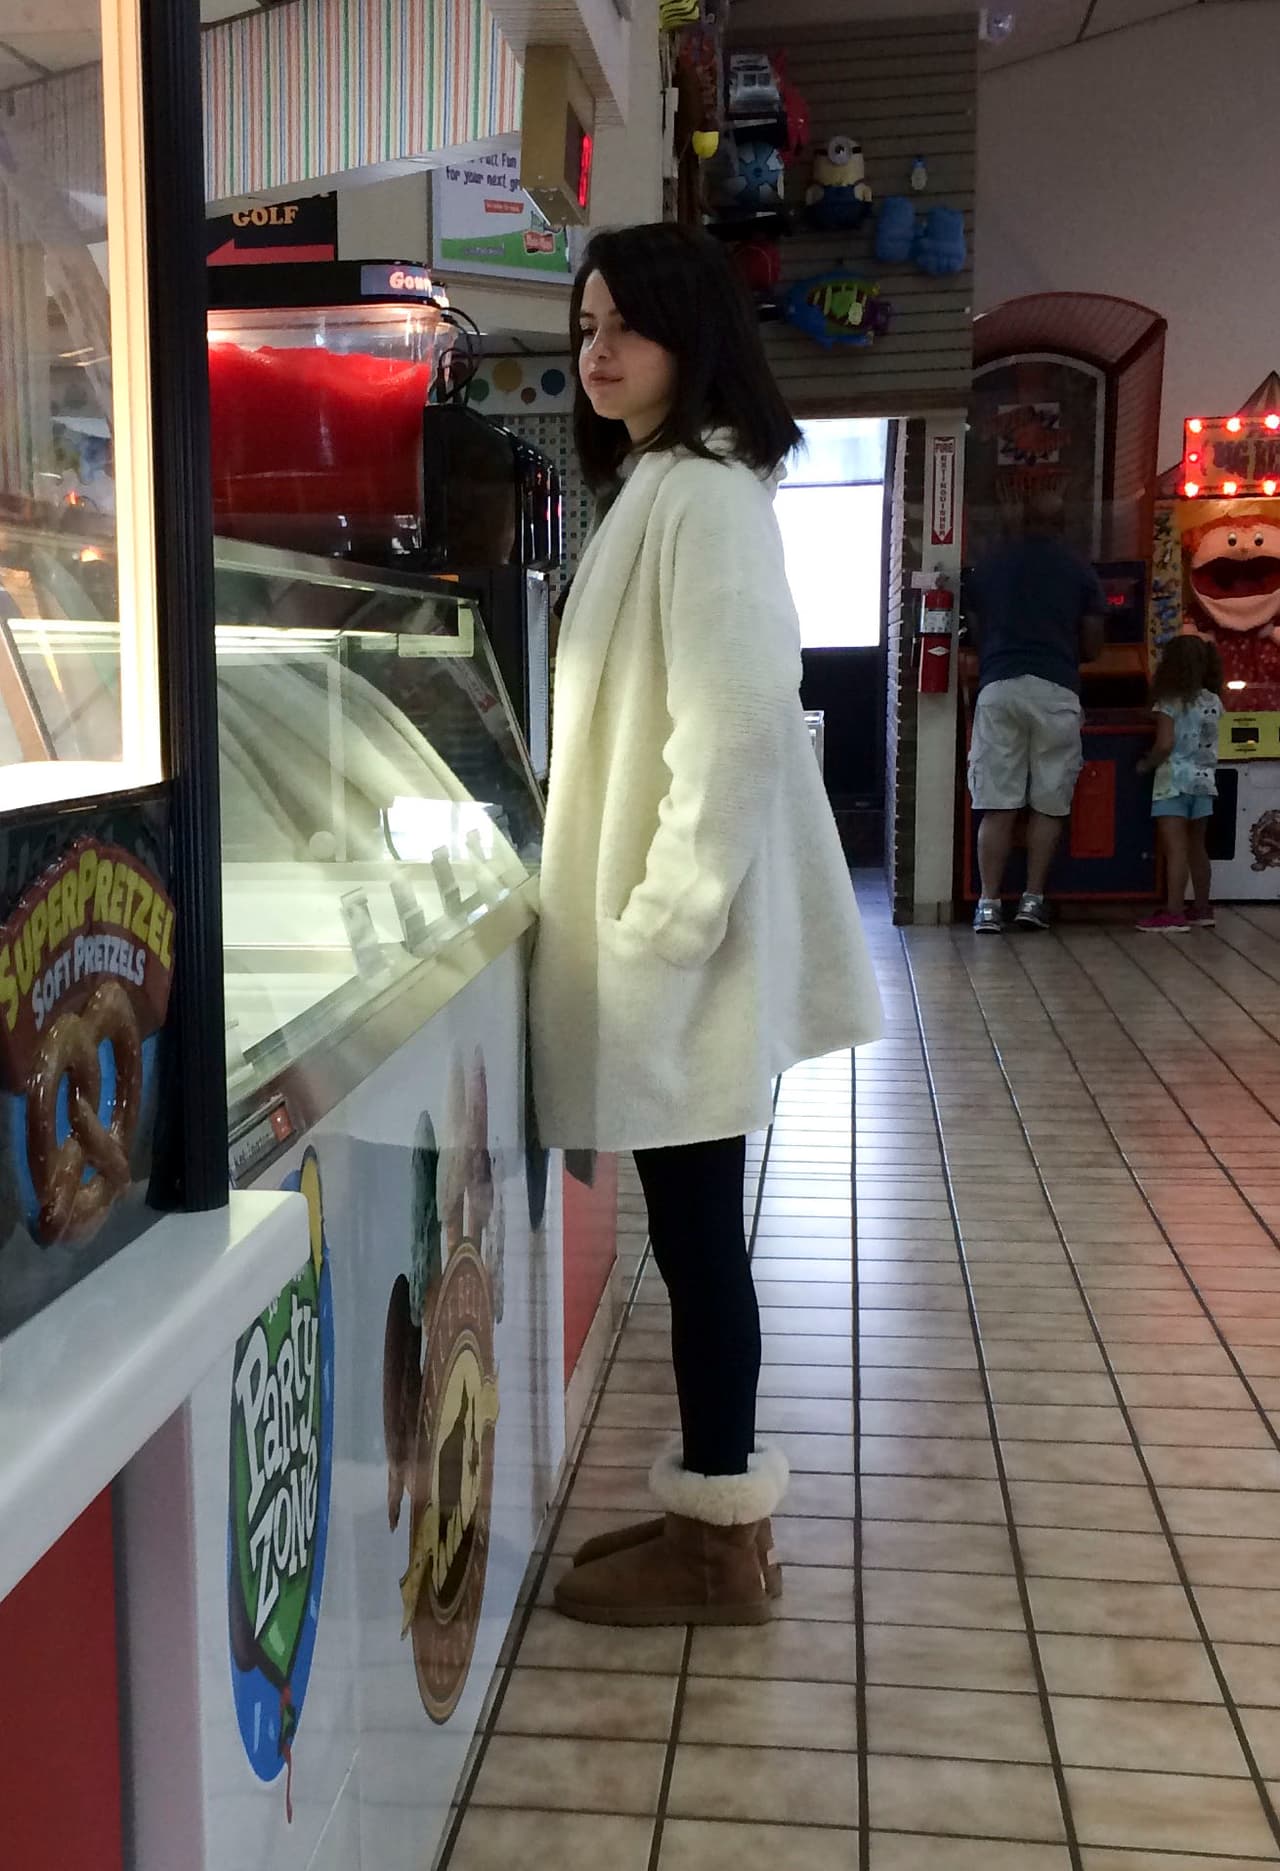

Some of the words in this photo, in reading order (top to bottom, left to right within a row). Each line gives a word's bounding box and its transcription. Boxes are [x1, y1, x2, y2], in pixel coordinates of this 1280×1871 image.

[232, 206, 299, 227] GOLF
[0, 849, 174, 1032] SUPERPRETZEL
[32, 949, 71, 1031] SOFT
[74, 934, 146, 986] PRETZELS
